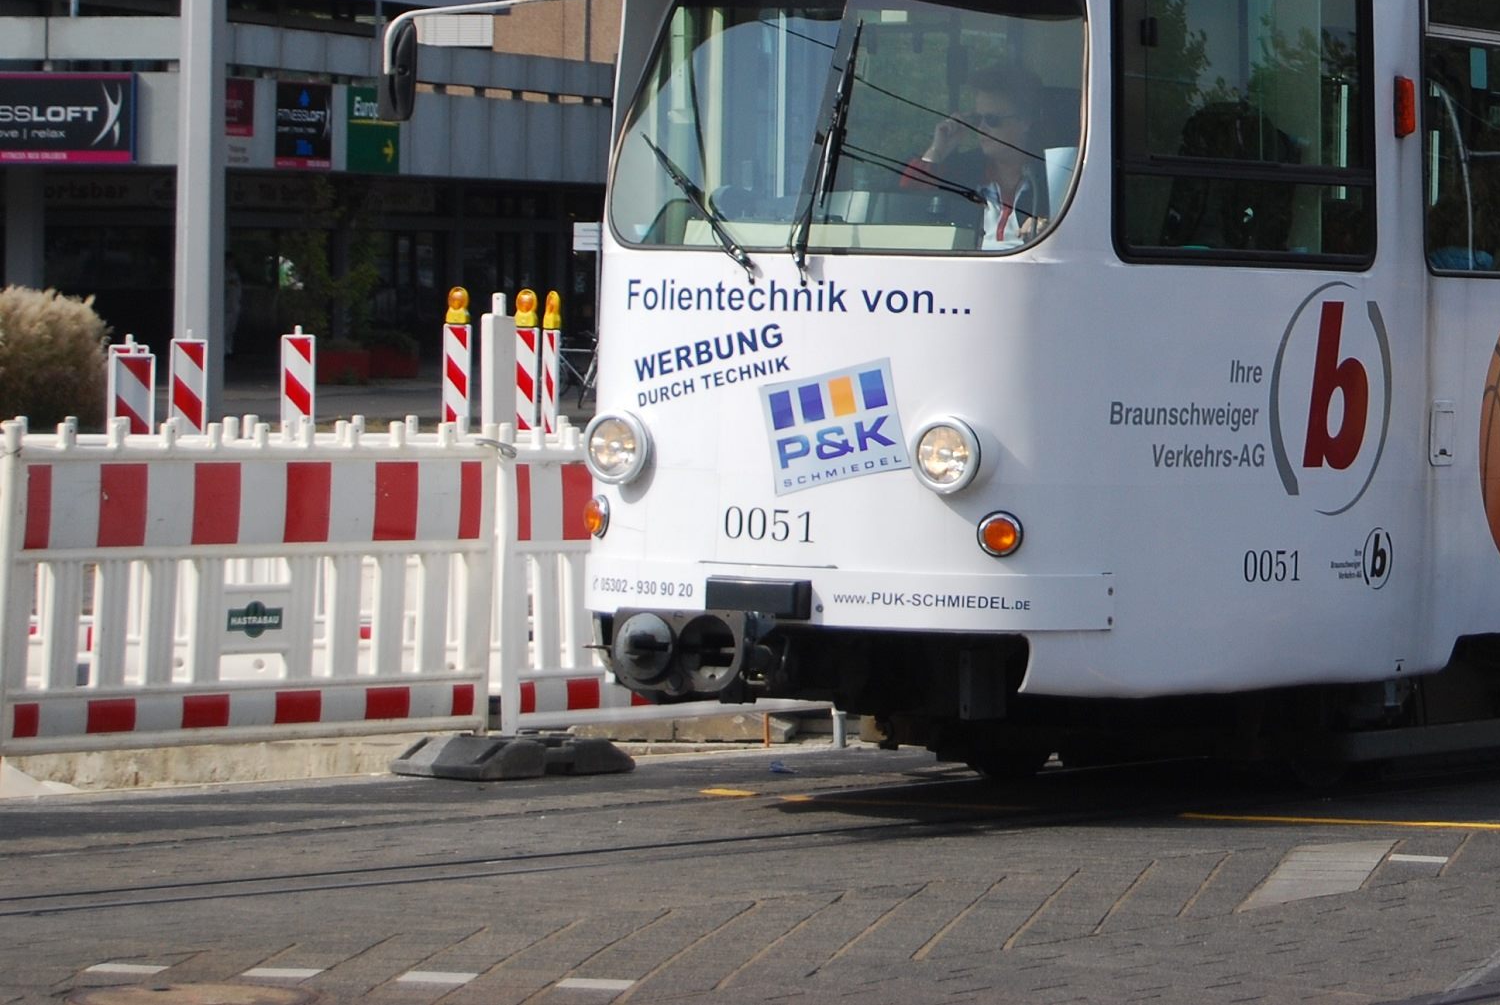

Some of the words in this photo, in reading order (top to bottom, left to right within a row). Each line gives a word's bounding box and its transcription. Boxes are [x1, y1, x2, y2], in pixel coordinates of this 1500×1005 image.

[627, 278, 848, 313] Folientechnik
[862, 289, 971, 315] von...
[634, 323, 785, 382] WERBUNG
[638, 378, 695, 408] DURCH
[701, 356, 791, 390] TECHNIK
[1229, 360, 1262, 384] Ihre
[1110, 401, 1259, 433] Braunschweiger
[775, 414, 897, 470] P&K
[1151, 443, 1265, 468] Verkehrs-AG
[783, 455, 902, 488] SCHMIEDEL
[724, 505, 815, 545] 0051
[1243, 550, 1300, 582] 0051
[636, 580, 657, 595] 930
[660, 581, 674, 596] 90
[678, 583, 693, 598] 20
[833, 592, 1031, 611] www.PUK-SCHMIEDEL.DE
